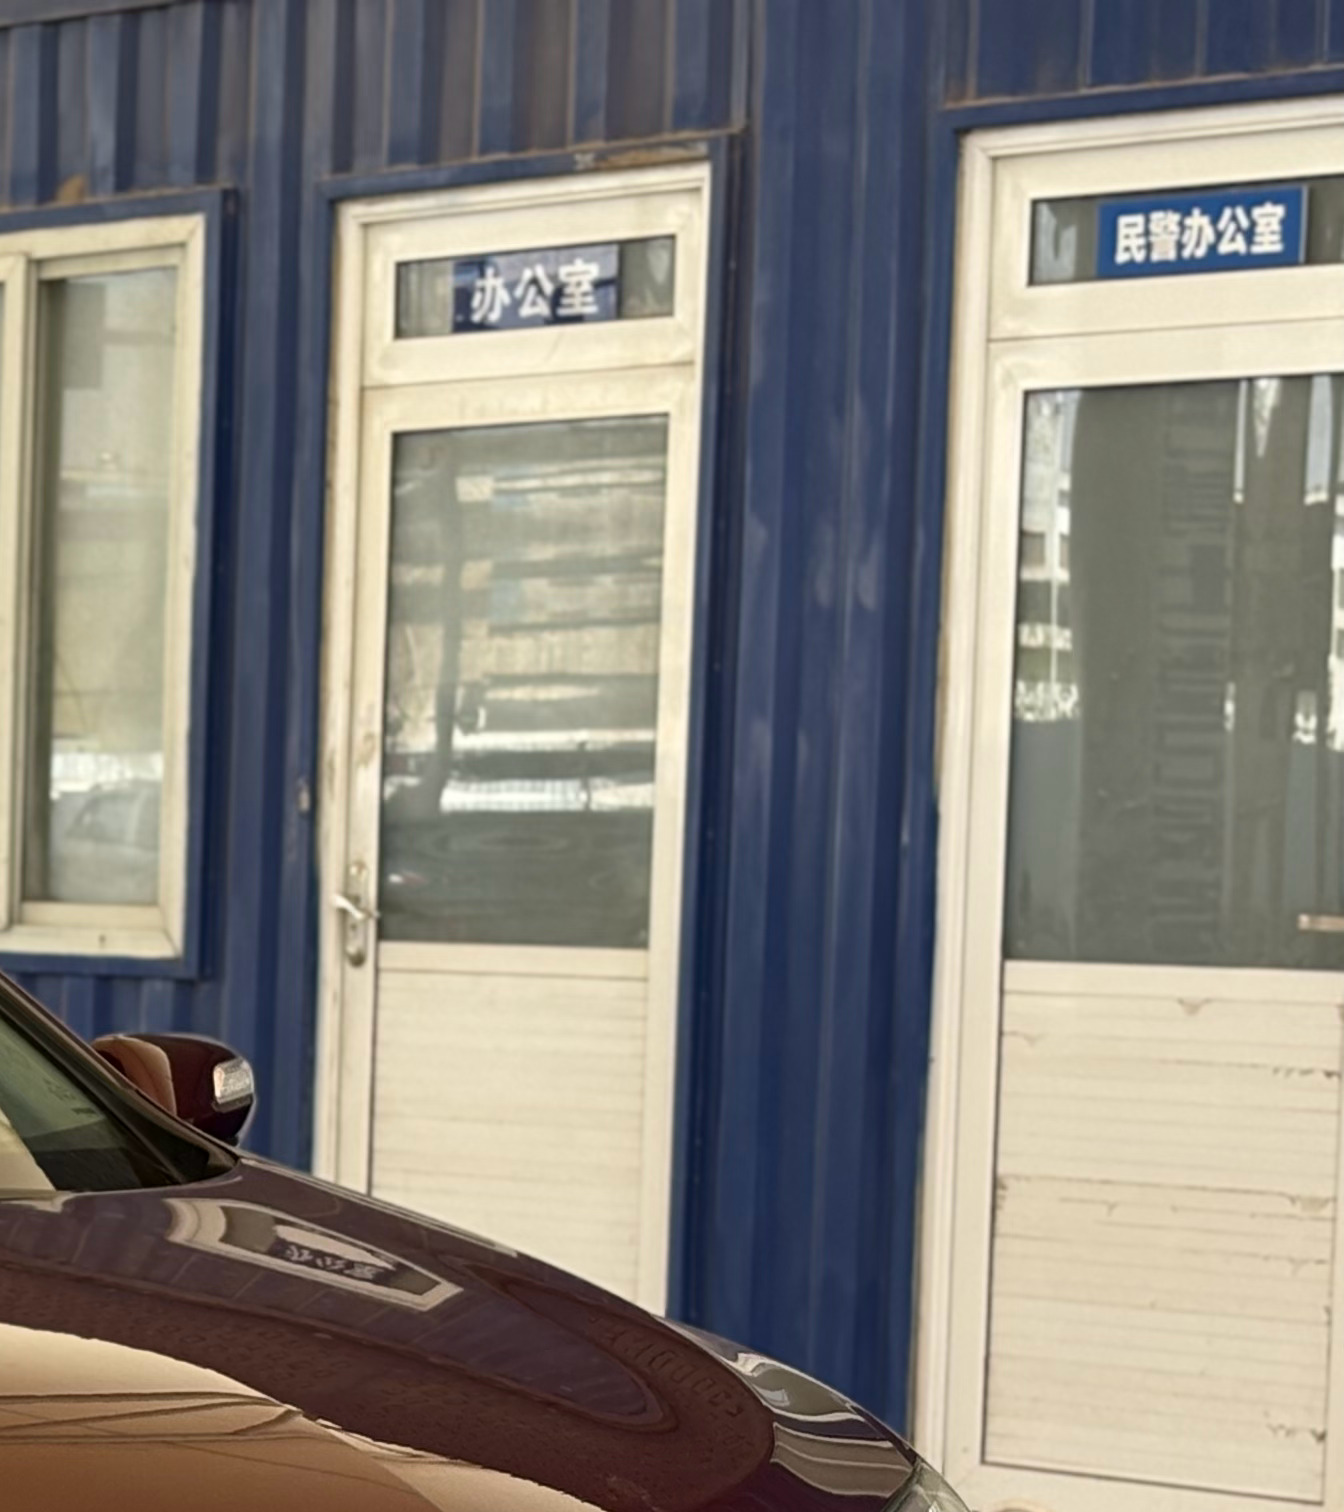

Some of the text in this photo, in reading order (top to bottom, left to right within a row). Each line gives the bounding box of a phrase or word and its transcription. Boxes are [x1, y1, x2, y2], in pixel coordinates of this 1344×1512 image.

[1114, 201, 1287, 265] 民警办公室
[469, 257, 601, 324] 办公室
